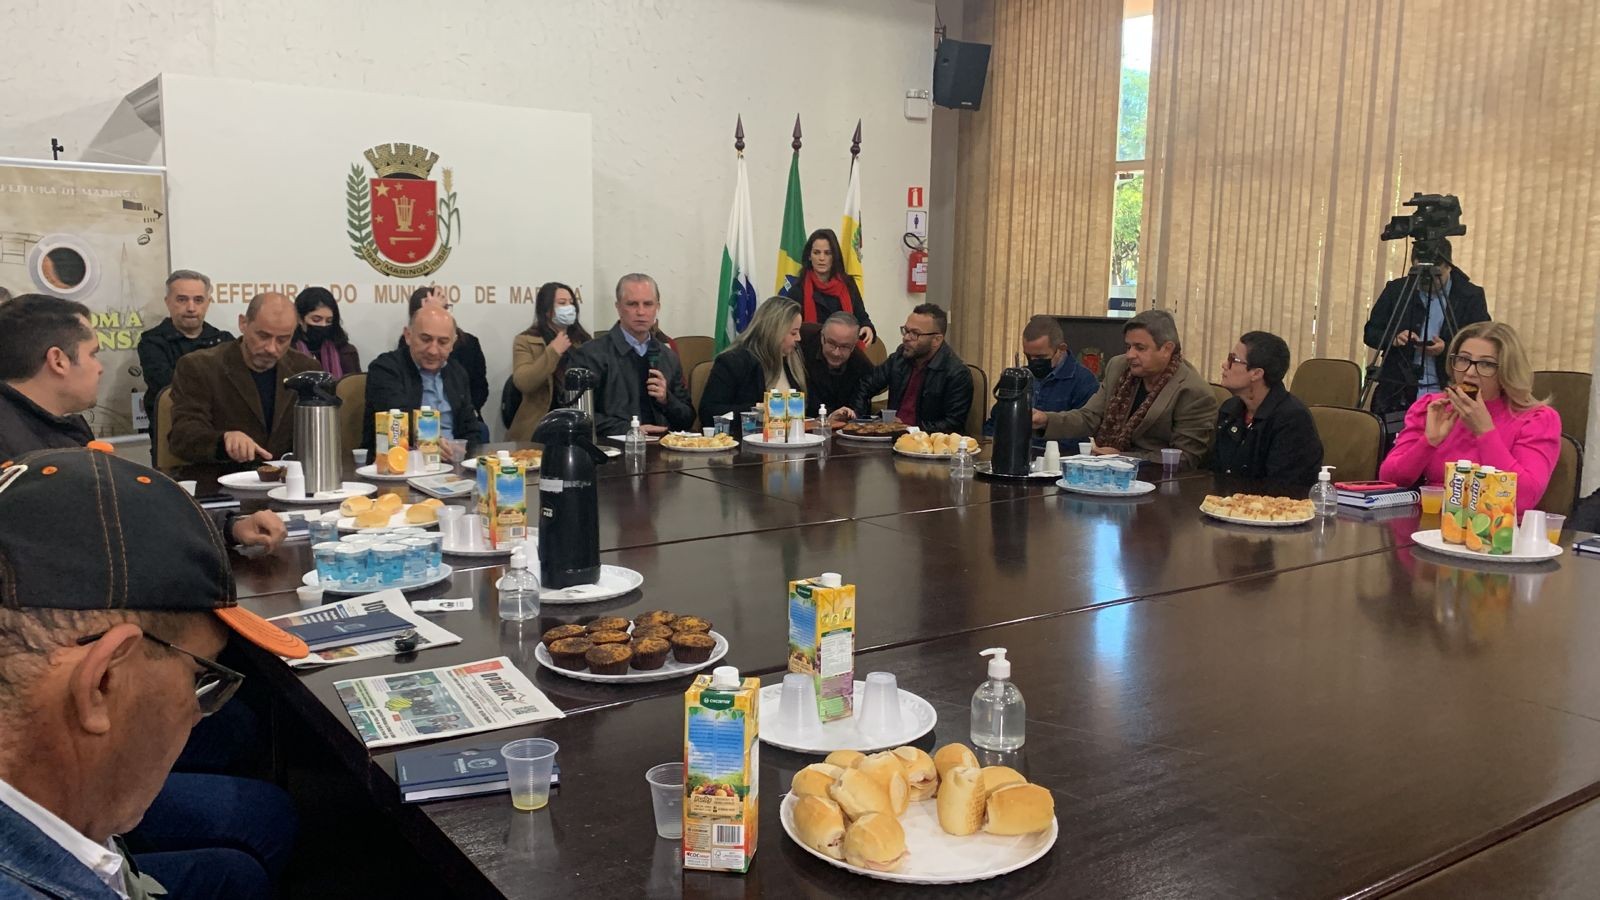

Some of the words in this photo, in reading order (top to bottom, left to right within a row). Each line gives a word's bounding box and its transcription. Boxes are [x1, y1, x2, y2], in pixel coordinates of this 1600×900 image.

[331, 284, 358, 304] DO
[475, 286, 496, 304] DE
[127, 311, 143, 328] A
[1449, 473, 1465, 506] Purity
[1469, 478, 1480, 511] Purity
[361, 600, 390, 613] JO
